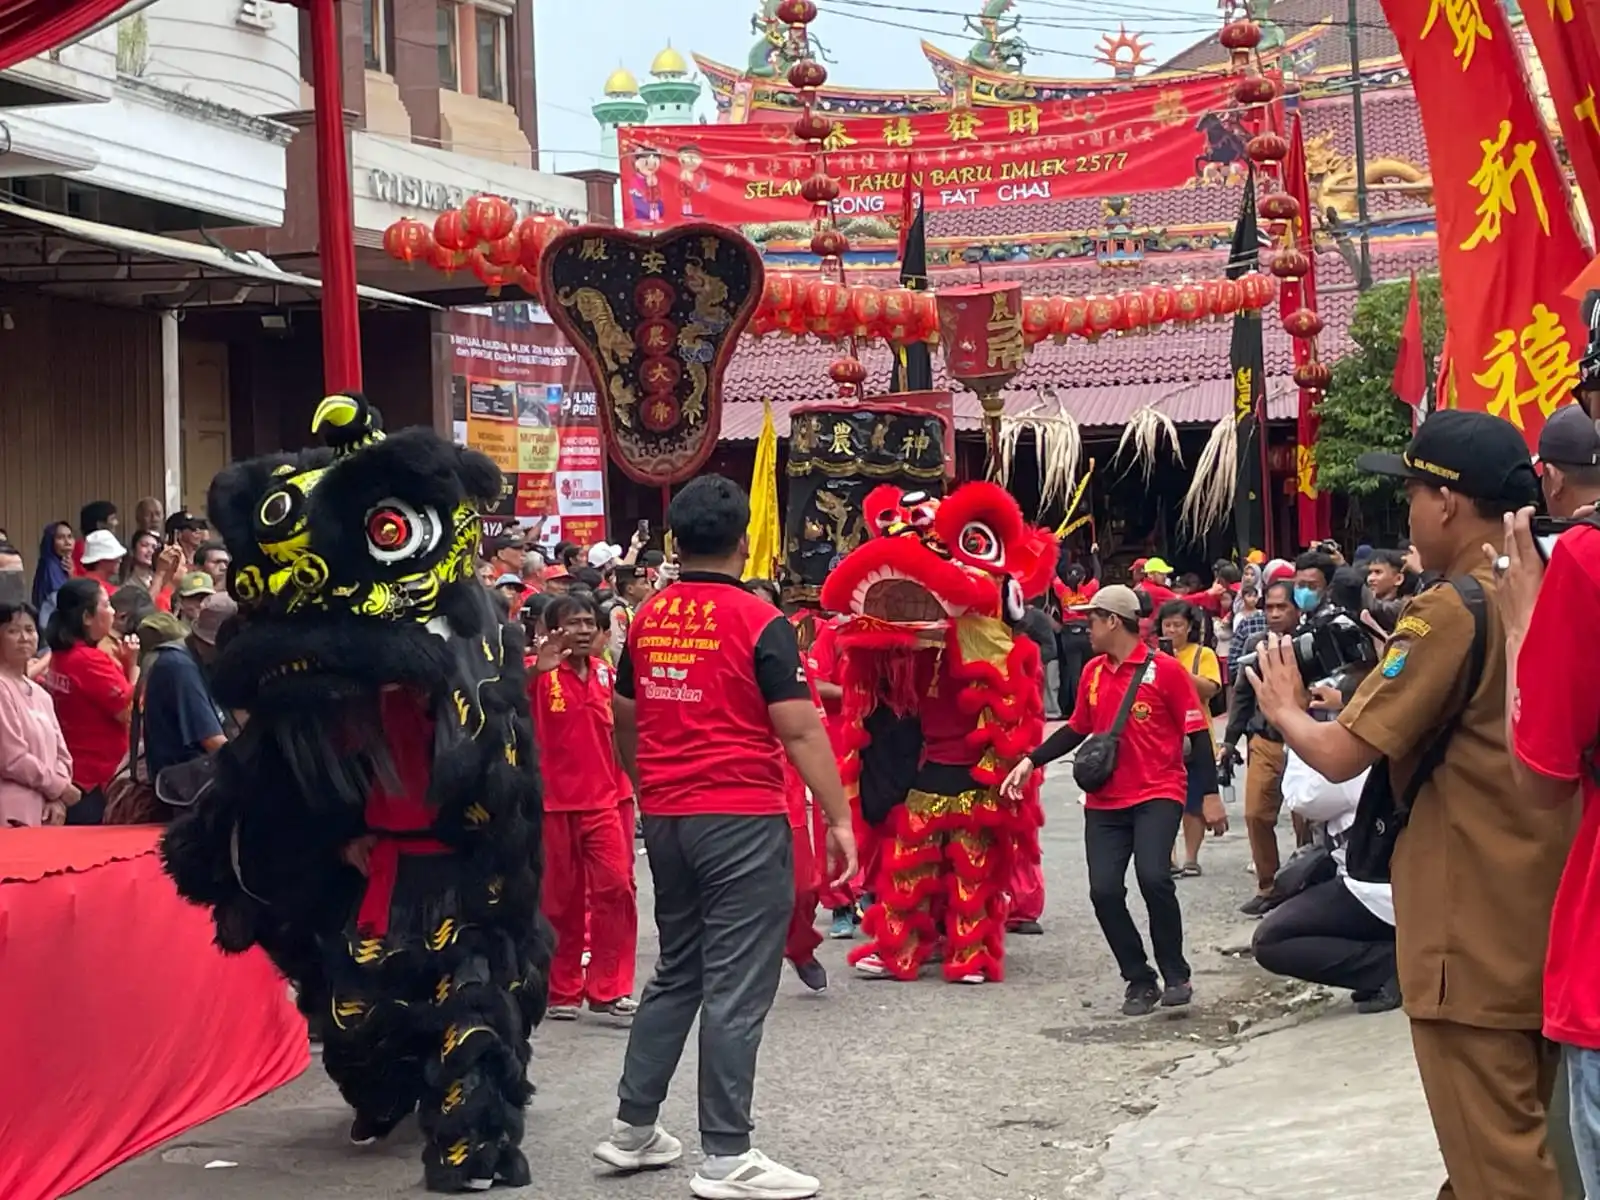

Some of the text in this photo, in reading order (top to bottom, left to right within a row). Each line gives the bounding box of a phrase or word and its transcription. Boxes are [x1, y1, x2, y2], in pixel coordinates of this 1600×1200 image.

[932, 165, 992, 186] BARU
[1000, 156, 1070, 180] IMLEK
[1076, 152, 1128, 173] 2577
[941, 187, 980, 206] FAT
[998, 181, 1051, 201] CHAI
